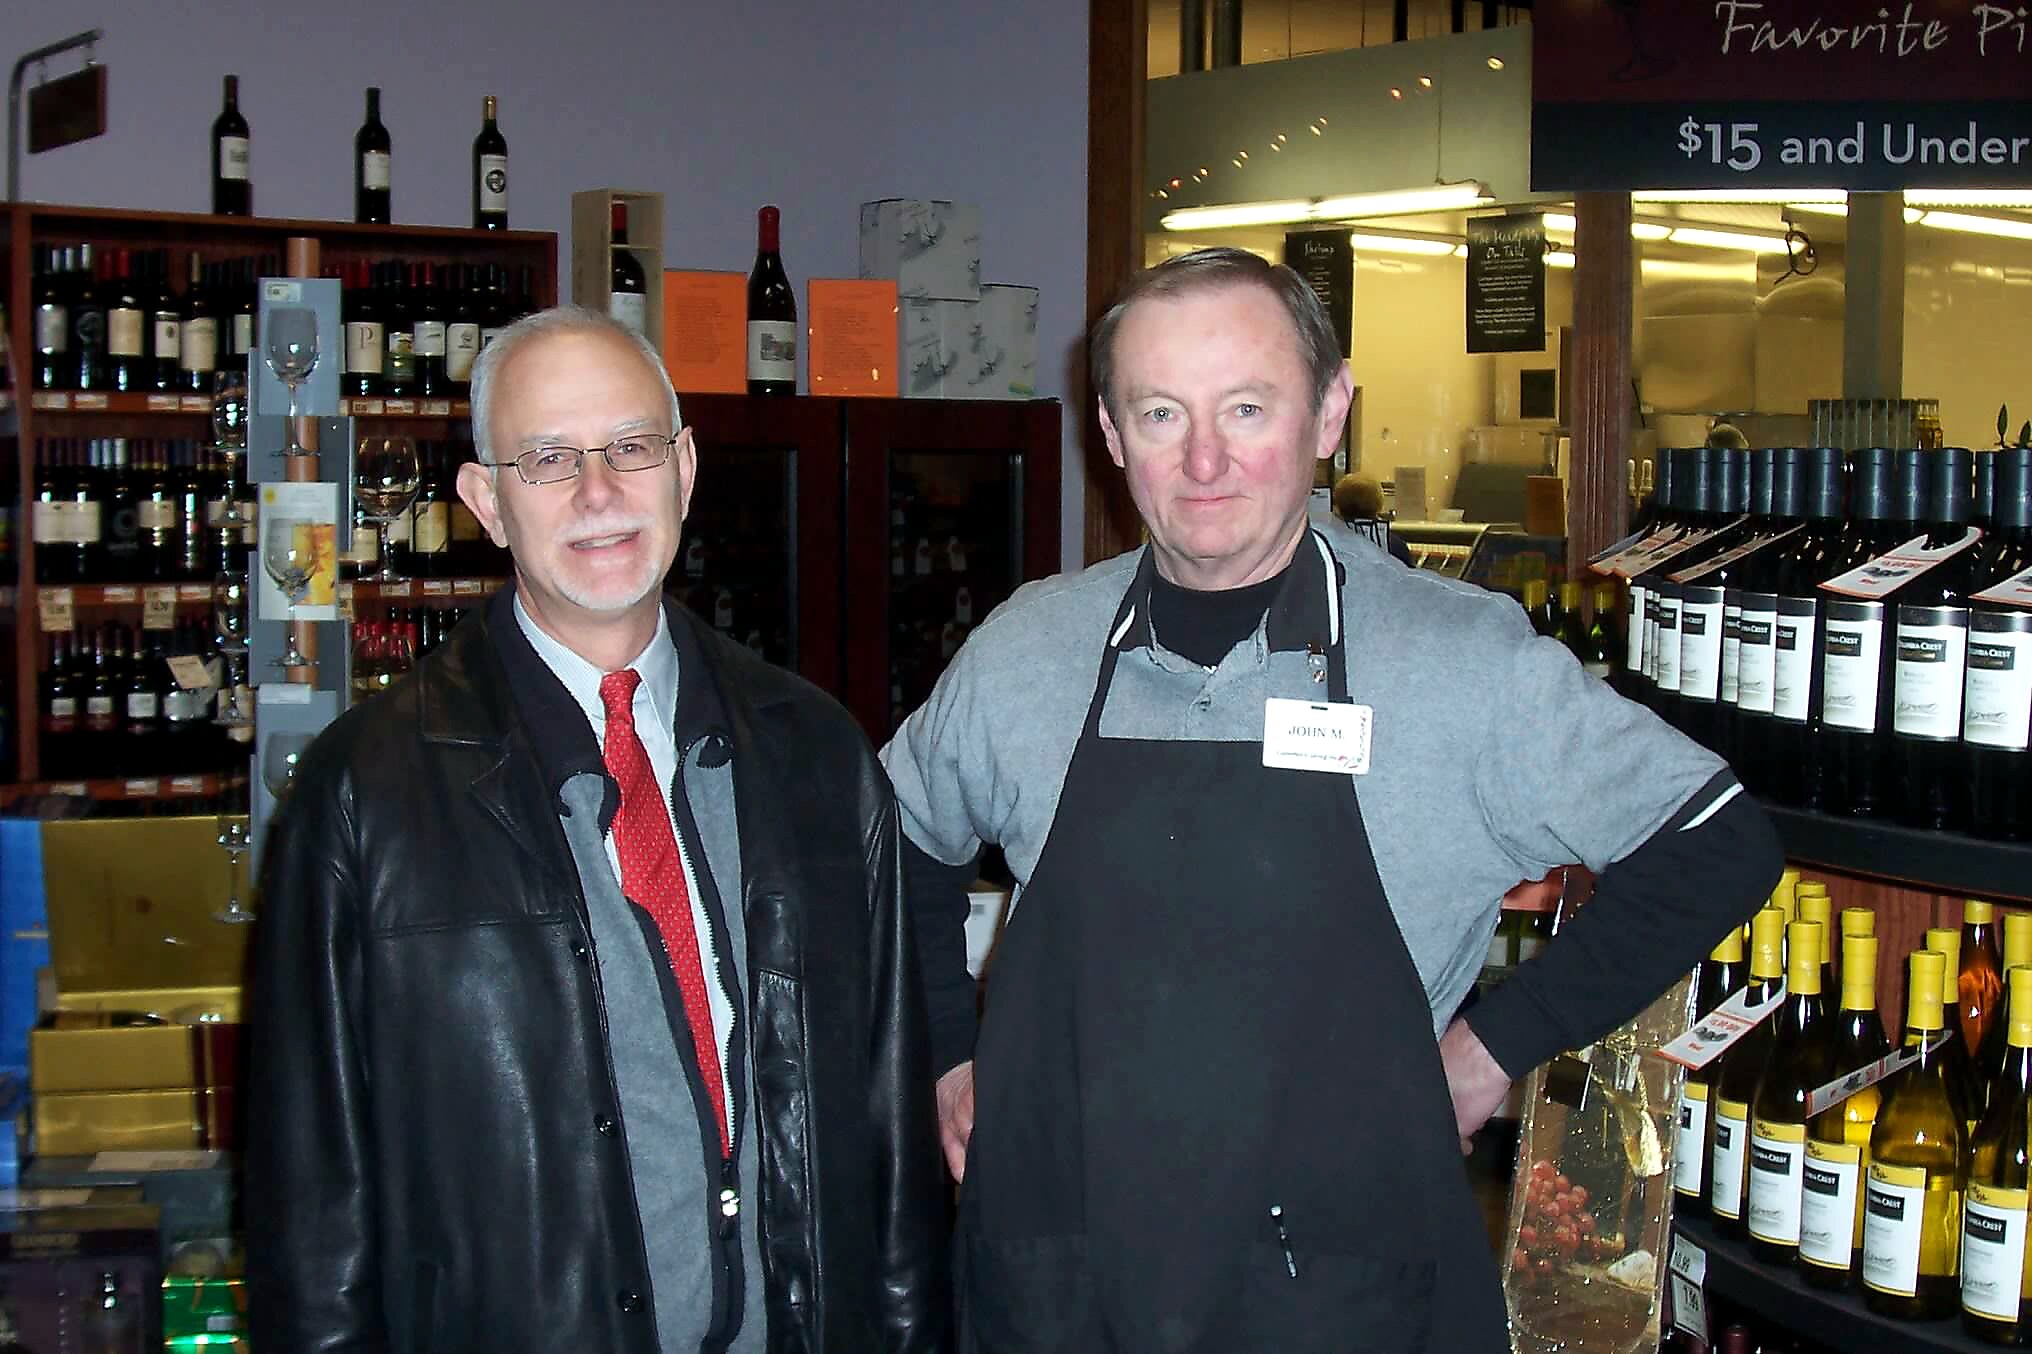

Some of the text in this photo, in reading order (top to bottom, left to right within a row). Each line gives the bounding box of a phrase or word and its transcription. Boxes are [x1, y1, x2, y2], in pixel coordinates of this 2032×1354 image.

[1716, 2, 1950, 56] Favorite
[1677, 116, 2031, 172] $15 and Under
[1288, 725, 1327, 737] JOHN
